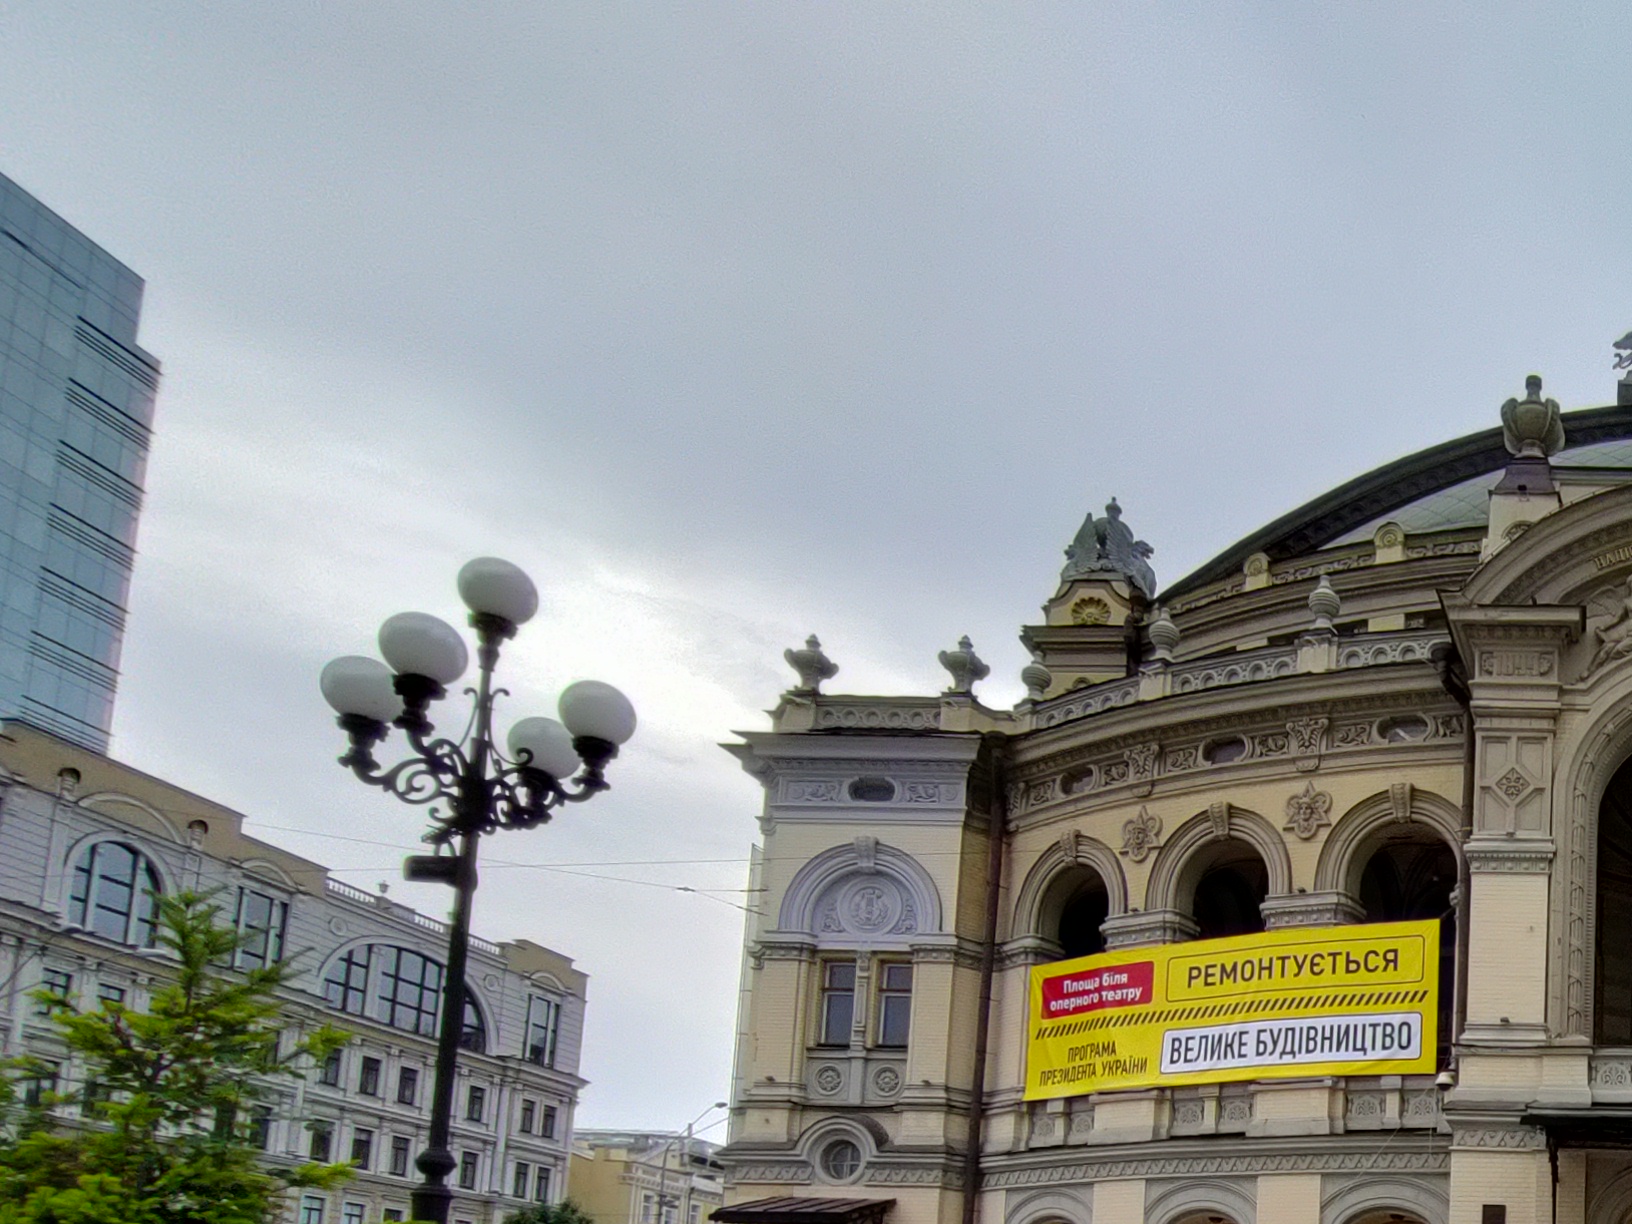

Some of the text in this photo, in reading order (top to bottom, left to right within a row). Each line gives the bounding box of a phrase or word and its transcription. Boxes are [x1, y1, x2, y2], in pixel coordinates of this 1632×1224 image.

[1063, 971, 1129, 995] Площа біля
[1187, 949, 1400, 989] РЕМОНТУЄТЬСЯ
[1049, 987, 1143, 1012] оперного театру
[1067, 1040, 1117, 1063] ПРОГРАМА
[1169, 1021, 1412, 1066] ВЕЛИКЕ БУДІВНИЦТВО
[1039, 1056, 1148, 1087] ПРЕЗИДЕНТА УКРАЇНИ
